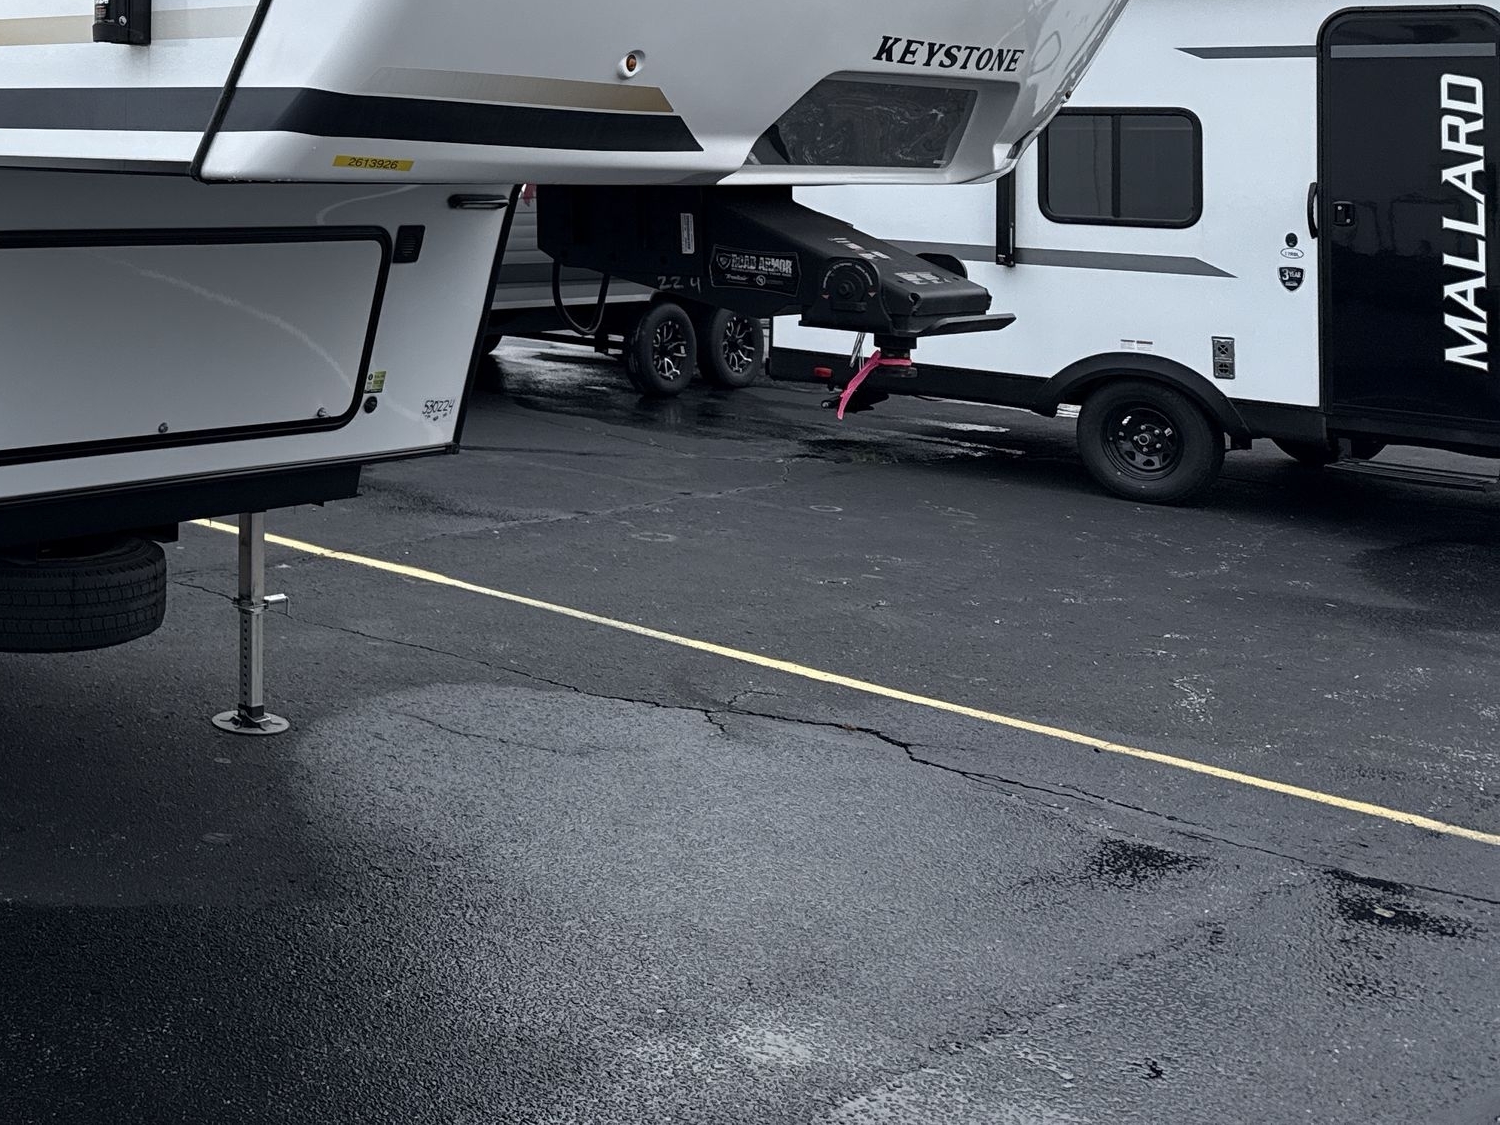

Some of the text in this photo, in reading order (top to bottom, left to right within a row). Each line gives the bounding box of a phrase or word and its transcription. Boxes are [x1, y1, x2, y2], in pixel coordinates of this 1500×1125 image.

[872, 35, 1025, 73] KEYSTONE
[348, 157, 399, 169] 2613926
[1440, 73, 1489, 371] MALLARD
[759, 256, 792, 274] ARMOR
